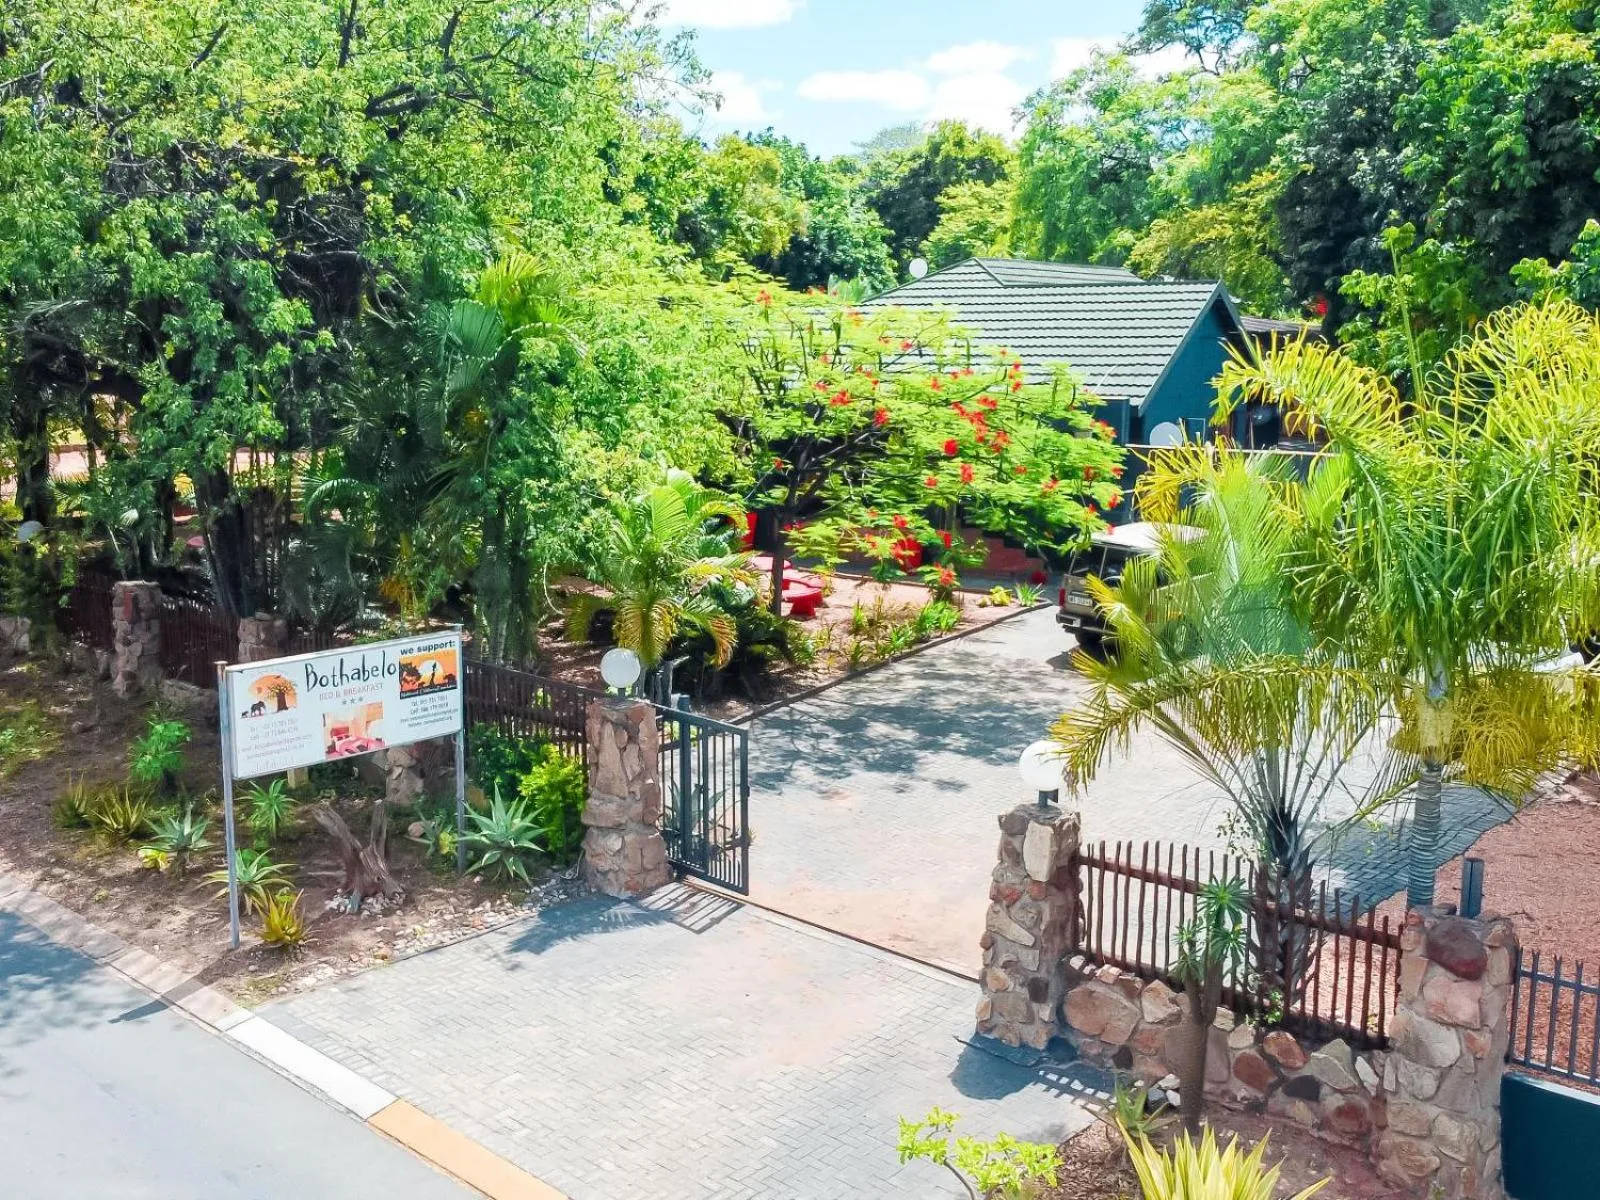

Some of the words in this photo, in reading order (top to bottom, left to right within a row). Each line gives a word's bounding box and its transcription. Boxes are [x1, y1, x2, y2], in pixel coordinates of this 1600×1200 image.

[400, 647, 414, 656] we
[417, 639, 456, 654] support:
[304, 649, 397, 693] Bothabelo
[319, 691, 334, 701] BED
[343, 683, 384, 697] BREAKFAST
